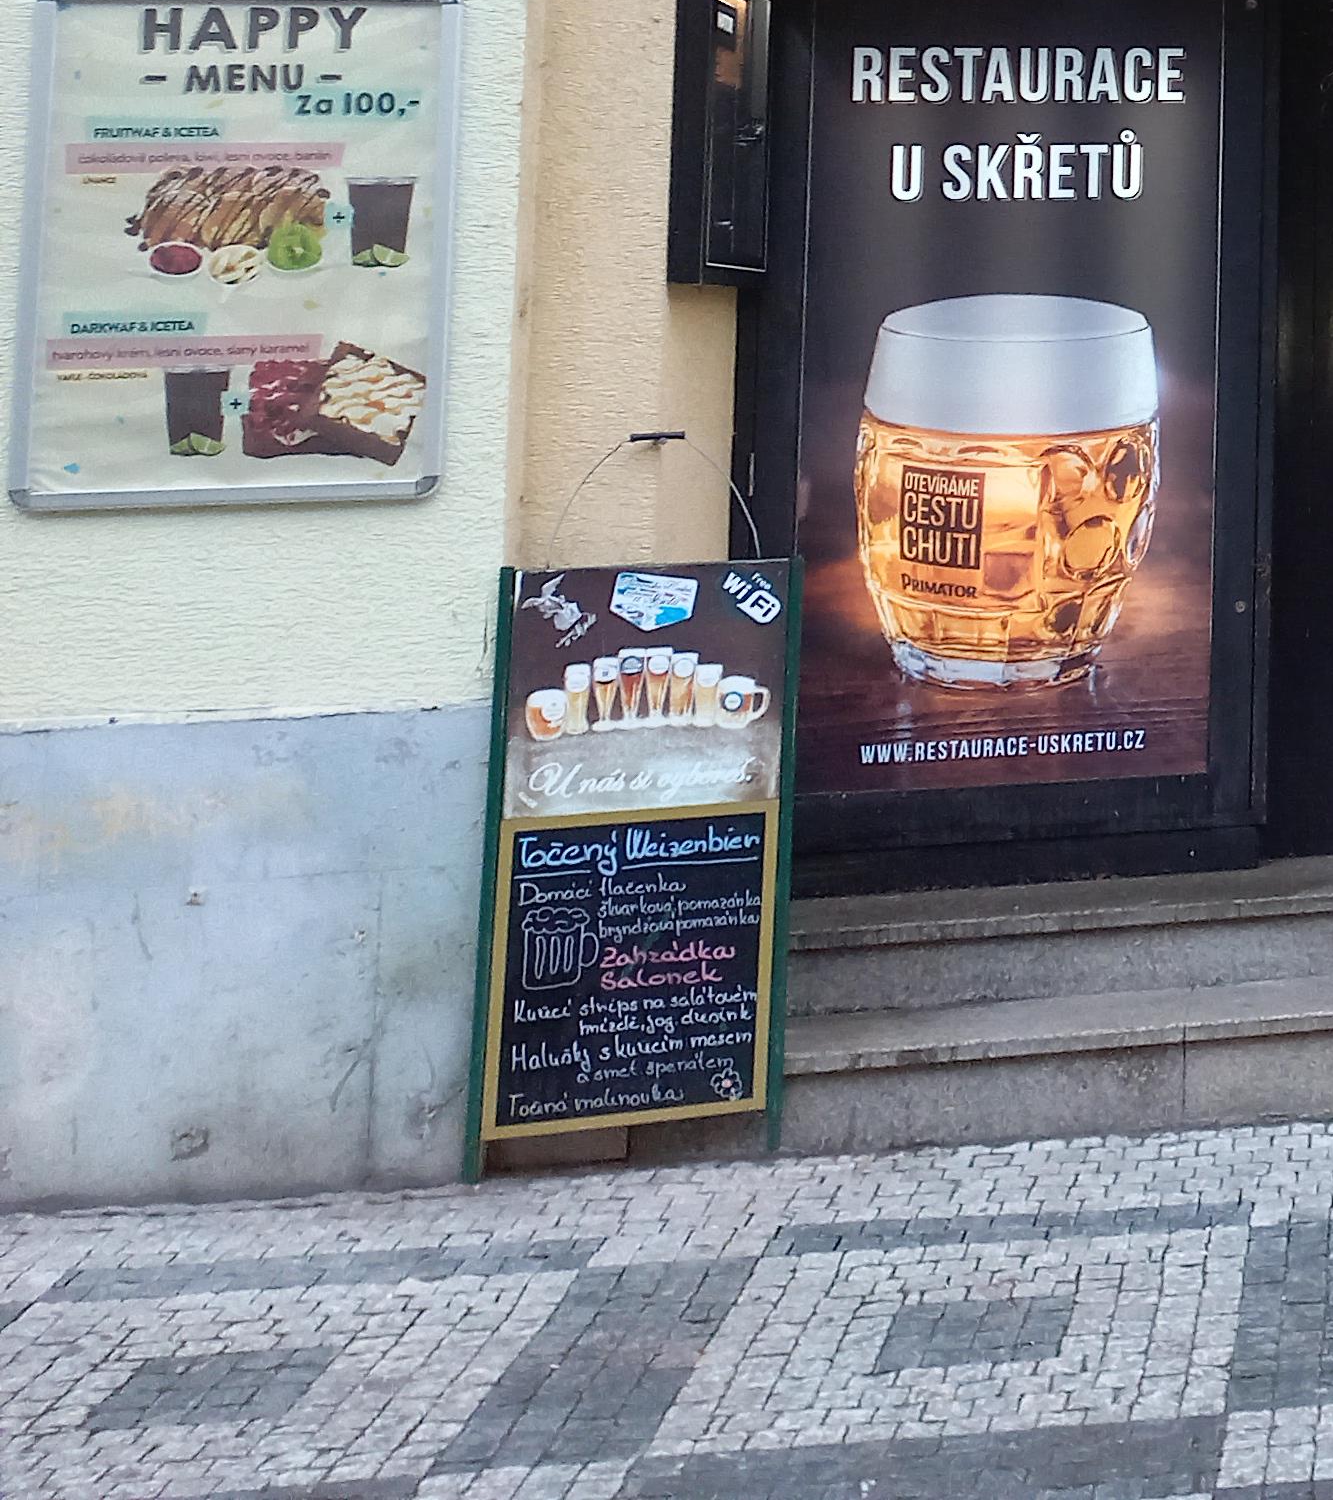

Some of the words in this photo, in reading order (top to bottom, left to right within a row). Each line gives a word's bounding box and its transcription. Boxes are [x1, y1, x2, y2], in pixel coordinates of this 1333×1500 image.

[140, 7, 369, 53] HAPPY
[184, 63, 304, 93] MENU
[851, 45, 1186, 105] RESTAURACE
[295, 94, 334, 116] Za
[343, 91, 420, 118] 100,-
[891, 143, 925, 202] U
[942, 128, 1145, 203] SKŘETŮ
[904, 472, 980, 497] OTEVÍRÁME
[903, 491, 979, 530] CESTU
[902, 526, 977, 566] CHUTI
[751, 572, 772, 590] Free
[901, 573, 977, 598] PRIMATOR
[860, 729, 1146, 764] WWW.RESTAURACE-USKRETU.CZ
[529, 762, 583, 798] U
[579, 768, 627, 794] nás
[519, 830, 619, 876] Točený
[600, 961, 723, 991] Salonek
